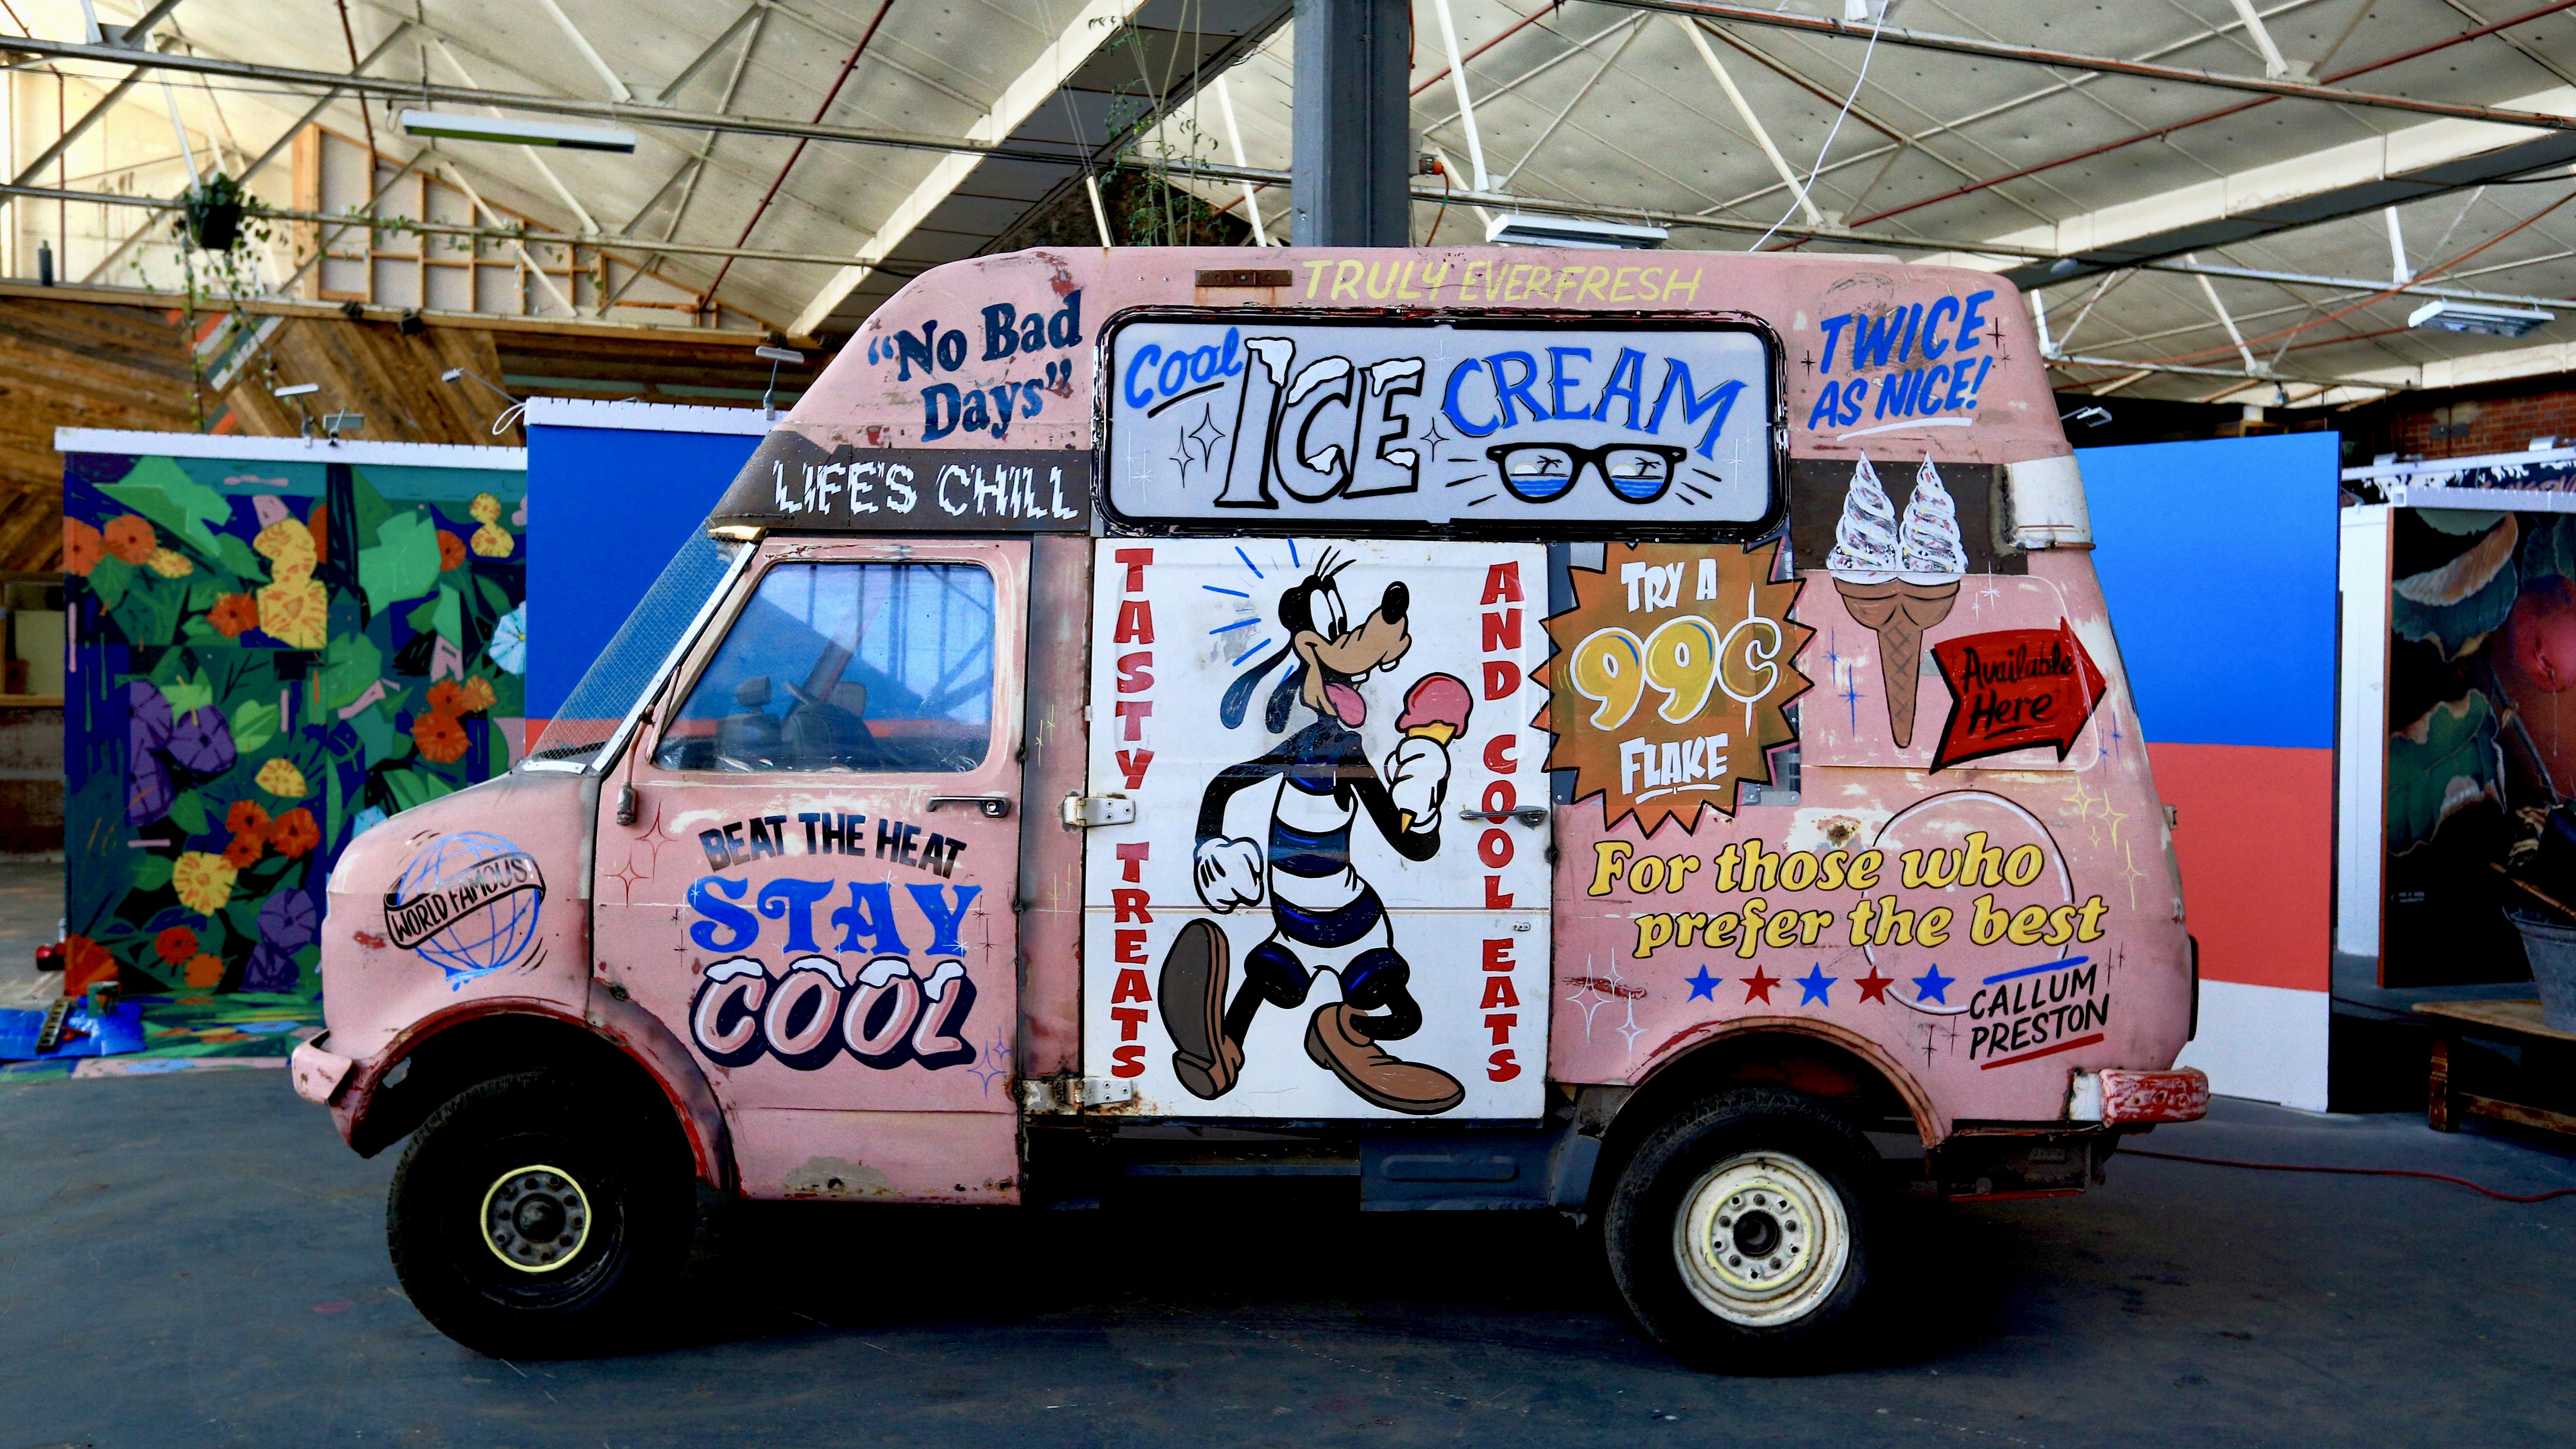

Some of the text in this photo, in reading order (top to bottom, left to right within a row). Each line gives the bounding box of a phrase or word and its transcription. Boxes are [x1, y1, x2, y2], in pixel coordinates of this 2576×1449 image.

[1302, 260, 1702, 303] TRULY EVERFRESH
[868, 290, 1082, 381] “No Bad
[1820, 290, 1994, 374] TWICE
[920, 358, 1072, 442] Days”
[1124, 327, 1747, 509] Cool ICE CREAM
[1807, 356, 1992, 430] AS NICE!
[772, 460, 1078, 520] LIFE'S CHILL
[1621, 558, 1717, 613] TRY A
[1959, 641, 2076, 693] Available
[1968, 690, 2057, 735] Here
[1619, 733, 1729, 795] FLAKE
[699, 813, 967, 879] BEAT THE HEAT
[1111, 548, 1155, 1078] TASTY TREATS
[1478, 561, 1524, 1082] AND COOL EATS
[1588, 831, 2044, 896] For those who
[391, 894, 448, 941] WORLD
[687, 875, 982, 957] STAY
[1632, 893, 2110, 958] prefer the best
[689, 954, 978, 1071] COOL
[1969, 964, 2097, 1019] CALLUM
[1970, 994, 2110, 1060] PRESTON
